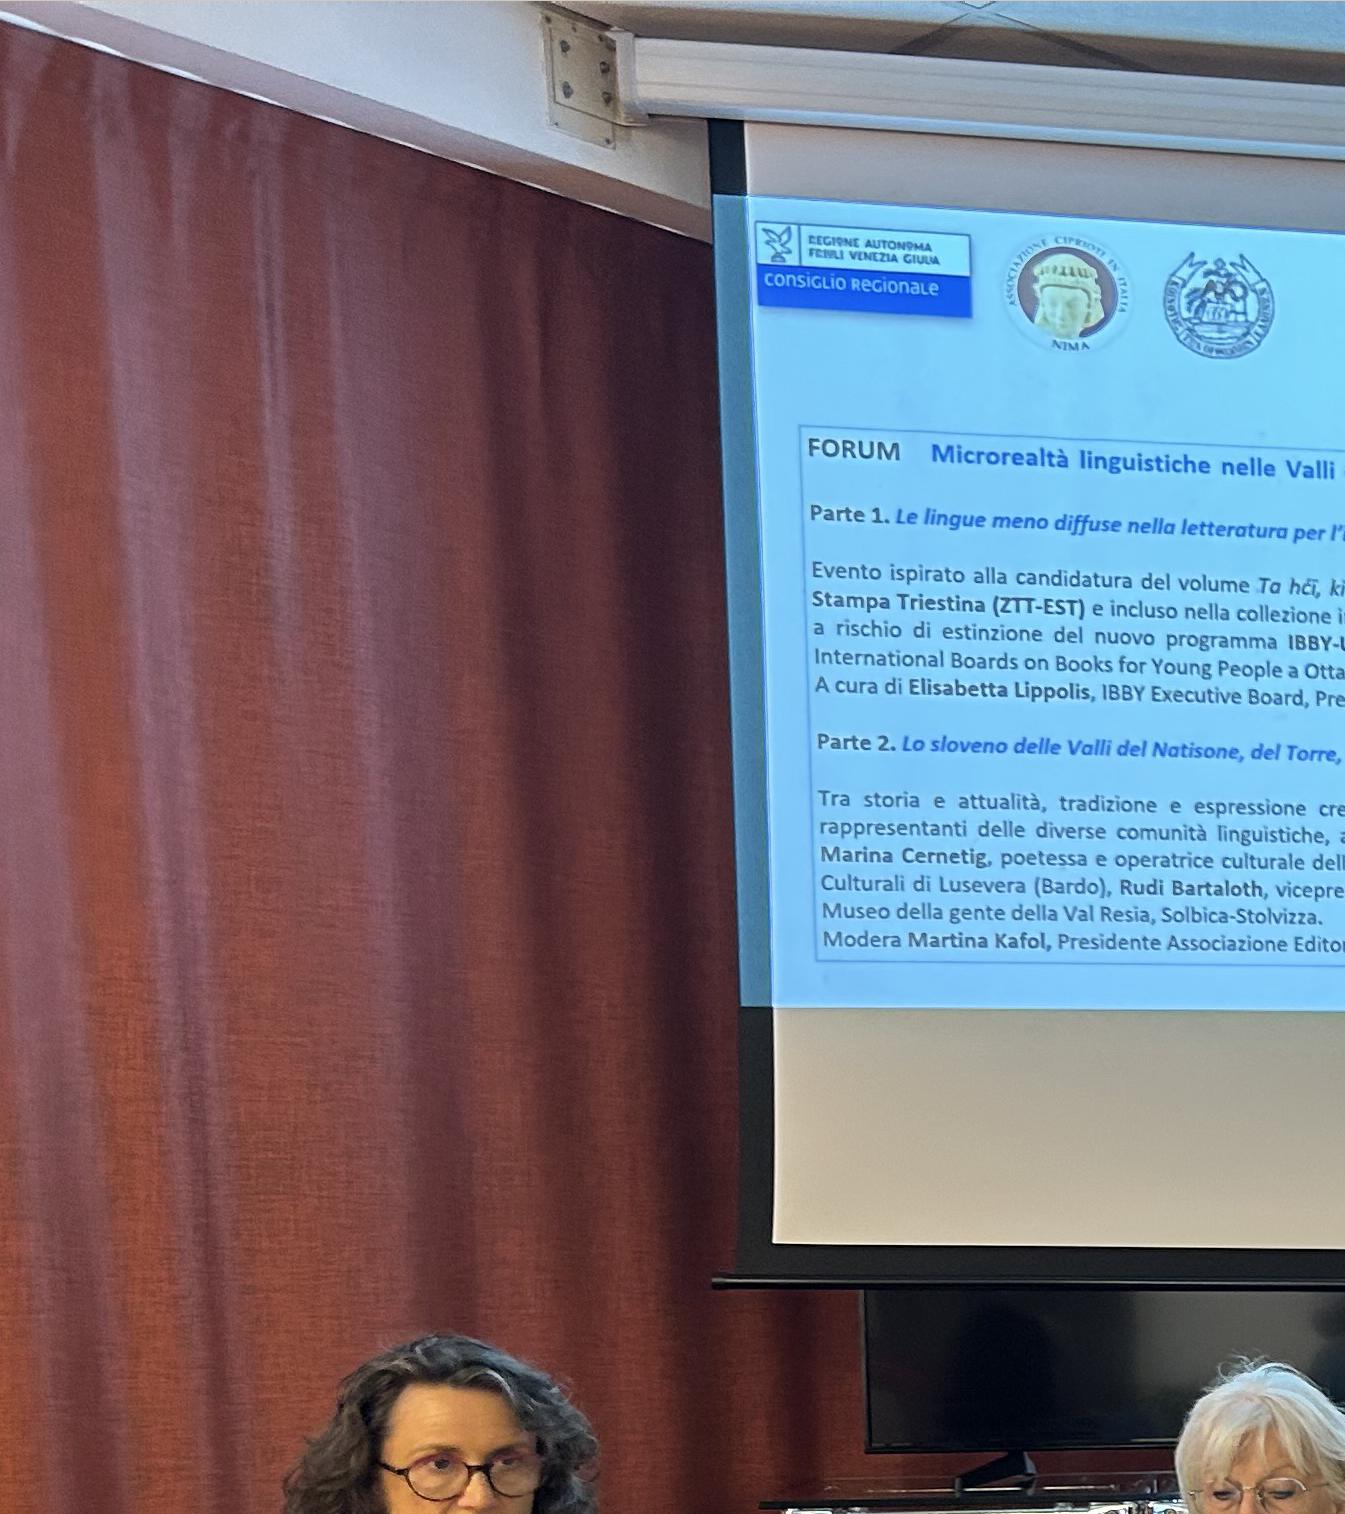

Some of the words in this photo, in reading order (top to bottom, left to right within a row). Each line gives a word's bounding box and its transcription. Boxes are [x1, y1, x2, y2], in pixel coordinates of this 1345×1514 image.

[808, 437, 901, 462] FORUM
[931, 443, 1070, 469] Microrealtà
[1079, 449, 1212, 475] linguistiche
[1221, 456, 1276, 478] nelle
[1285, 459, 1336, 480] Valli
[810, 504, 866, 523] Parte
[871, 507, 891, 524] 1.
[894, 508, 919, 525] Le
[923, 507, 987, 532] lingue
[991, 515, 1049, 530] meno
[1053, 513, 1123, 537] diffuse
[1126, 516, 1177, 536] nella
[1180, 517, 1289, 540] letteratura
[1291, 527, 1327, 545] per
[814, 645, 945, 669] International
[949, 649, 1020, 672] Boards
[1022, 655, 1051, 672] on
[1053, 654, 1114, 674] Books
[1117, 653, 1148, 675] for
[1150, 657, 1213, 681] Young
[1216, 659, 1284, 682] People
[1287, 664, 1299, 679] a
[815, 675, 830, 693] A
[834, 679, 879, 695] cura
[884, 675, 904, 695] di
[908, 676, 1009, 698] Elisabetta
[1012, 678, 1097, 704] Lippolis,
[1101, 682, 1146, 702] IBBY
[1150, 684, 1243, 705] Executive
[1246, 686, 1310, 709] Board,
[817, 732, 873, 751] Parte
[876, 734, 897, 752] 2.
[901, 735, 926, 752] Lo
[929, 734, 1009, 754] sloveno
[1013, 736, 1062, 756] delle
[1066, 738, 1113, 757] Valli
[1115, 738, 1148, 758] del
[1151, 741, 1245, 764] Natisone,
[1250, 742, 1282, 761] del
[1285, 744, 1342, 766] Torre,
[822, 901, 892, 921] Museo
[893, 901, 944, 923] della
[948, 903, 1007, 925] gente
[1010, 901, 1059, 922] della
[1061, 903, 1095, 923] Val
[1099, 903, 1157, 927] Resia,
[1158, 903, 1323, 929] Solbica-Stolvizza.
[823, 926, 902, 948] Modera
[907, 929, 989, 949] Martina
[994, 930, 1053, 953] Kafol,
[1056, 931, 1162, 951] Presidente
[1165, 930, 1289, 953] Associazione
